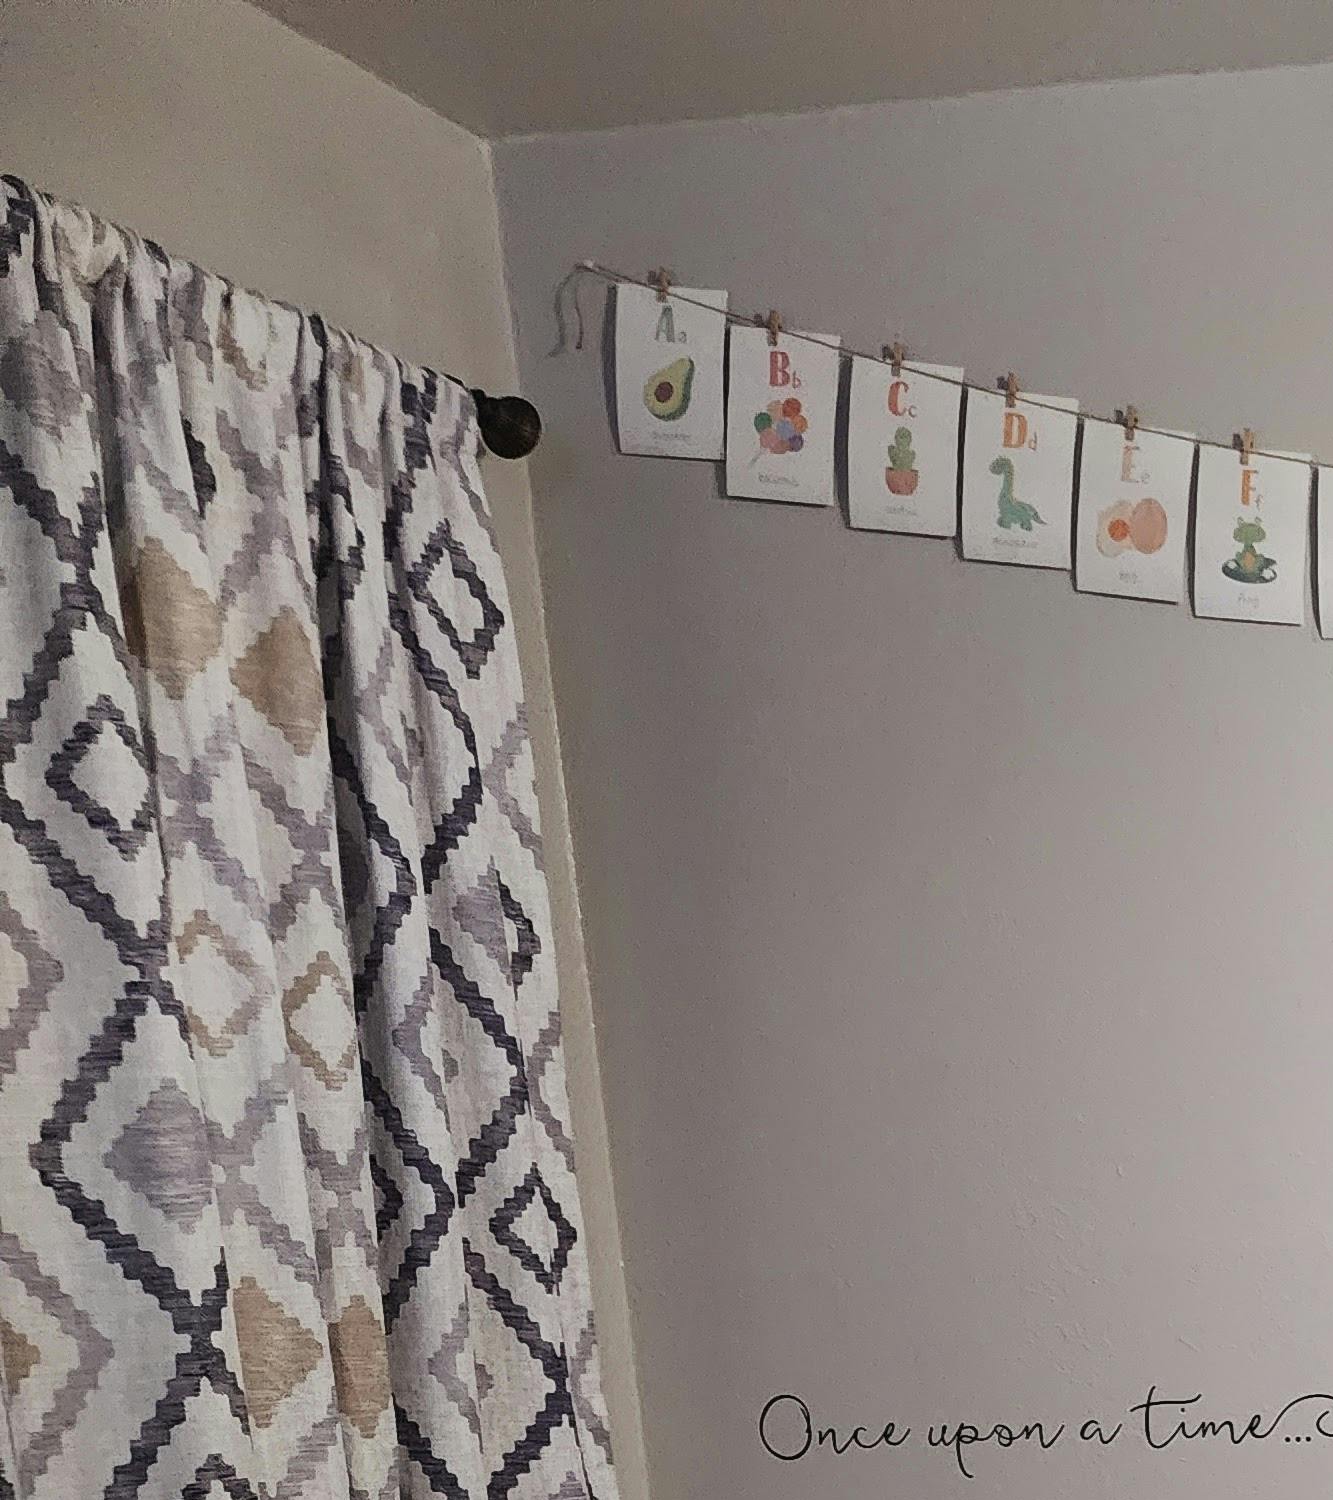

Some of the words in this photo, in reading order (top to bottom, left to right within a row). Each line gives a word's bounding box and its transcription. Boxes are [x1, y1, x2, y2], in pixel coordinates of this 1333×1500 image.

[769, 351, 803, 389] Bb
[1003, 412, 1038, 451] Dd
[760, 1394, 911, 1461] Once
[927, 1422, 1065, 1479] upon
[1080, 1417, 1122, 1446] a
